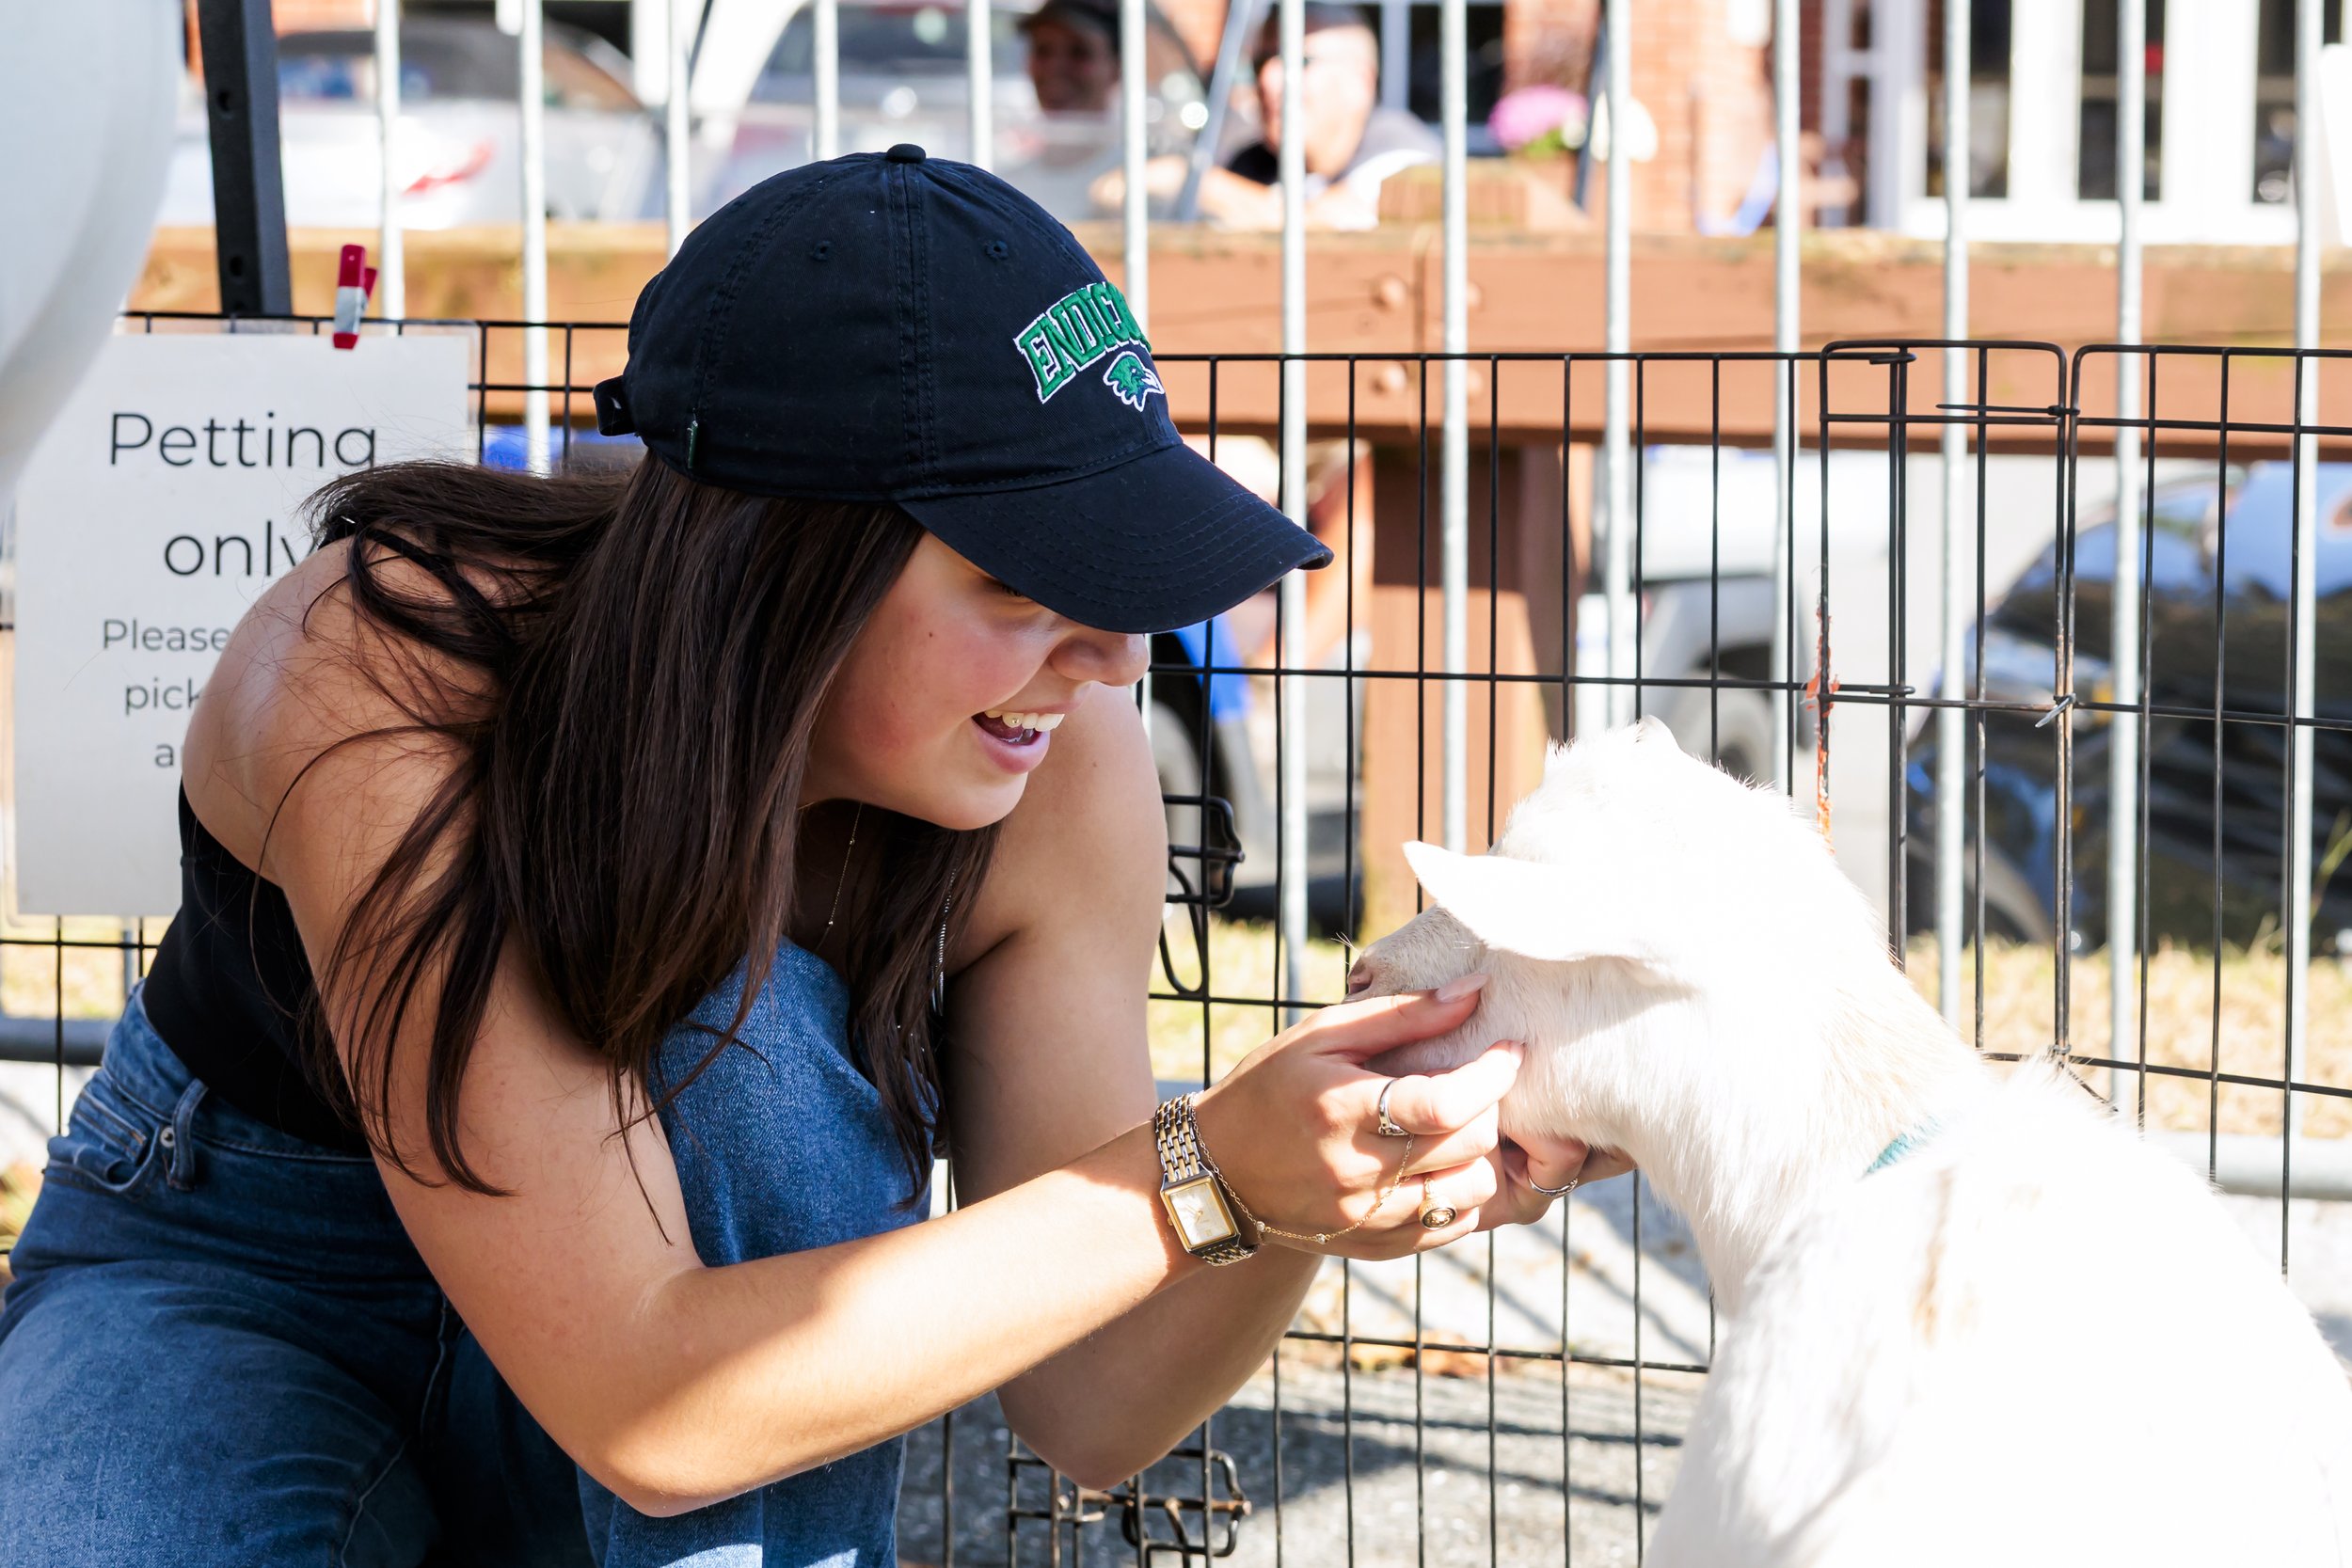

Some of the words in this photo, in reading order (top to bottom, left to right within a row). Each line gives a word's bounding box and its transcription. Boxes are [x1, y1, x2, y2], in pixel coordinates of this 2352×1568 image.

[1012, 281, 1152, 404] ENDIC
[109, 411, 375, 470] Petting
[103, 617, 230, 652] Please
